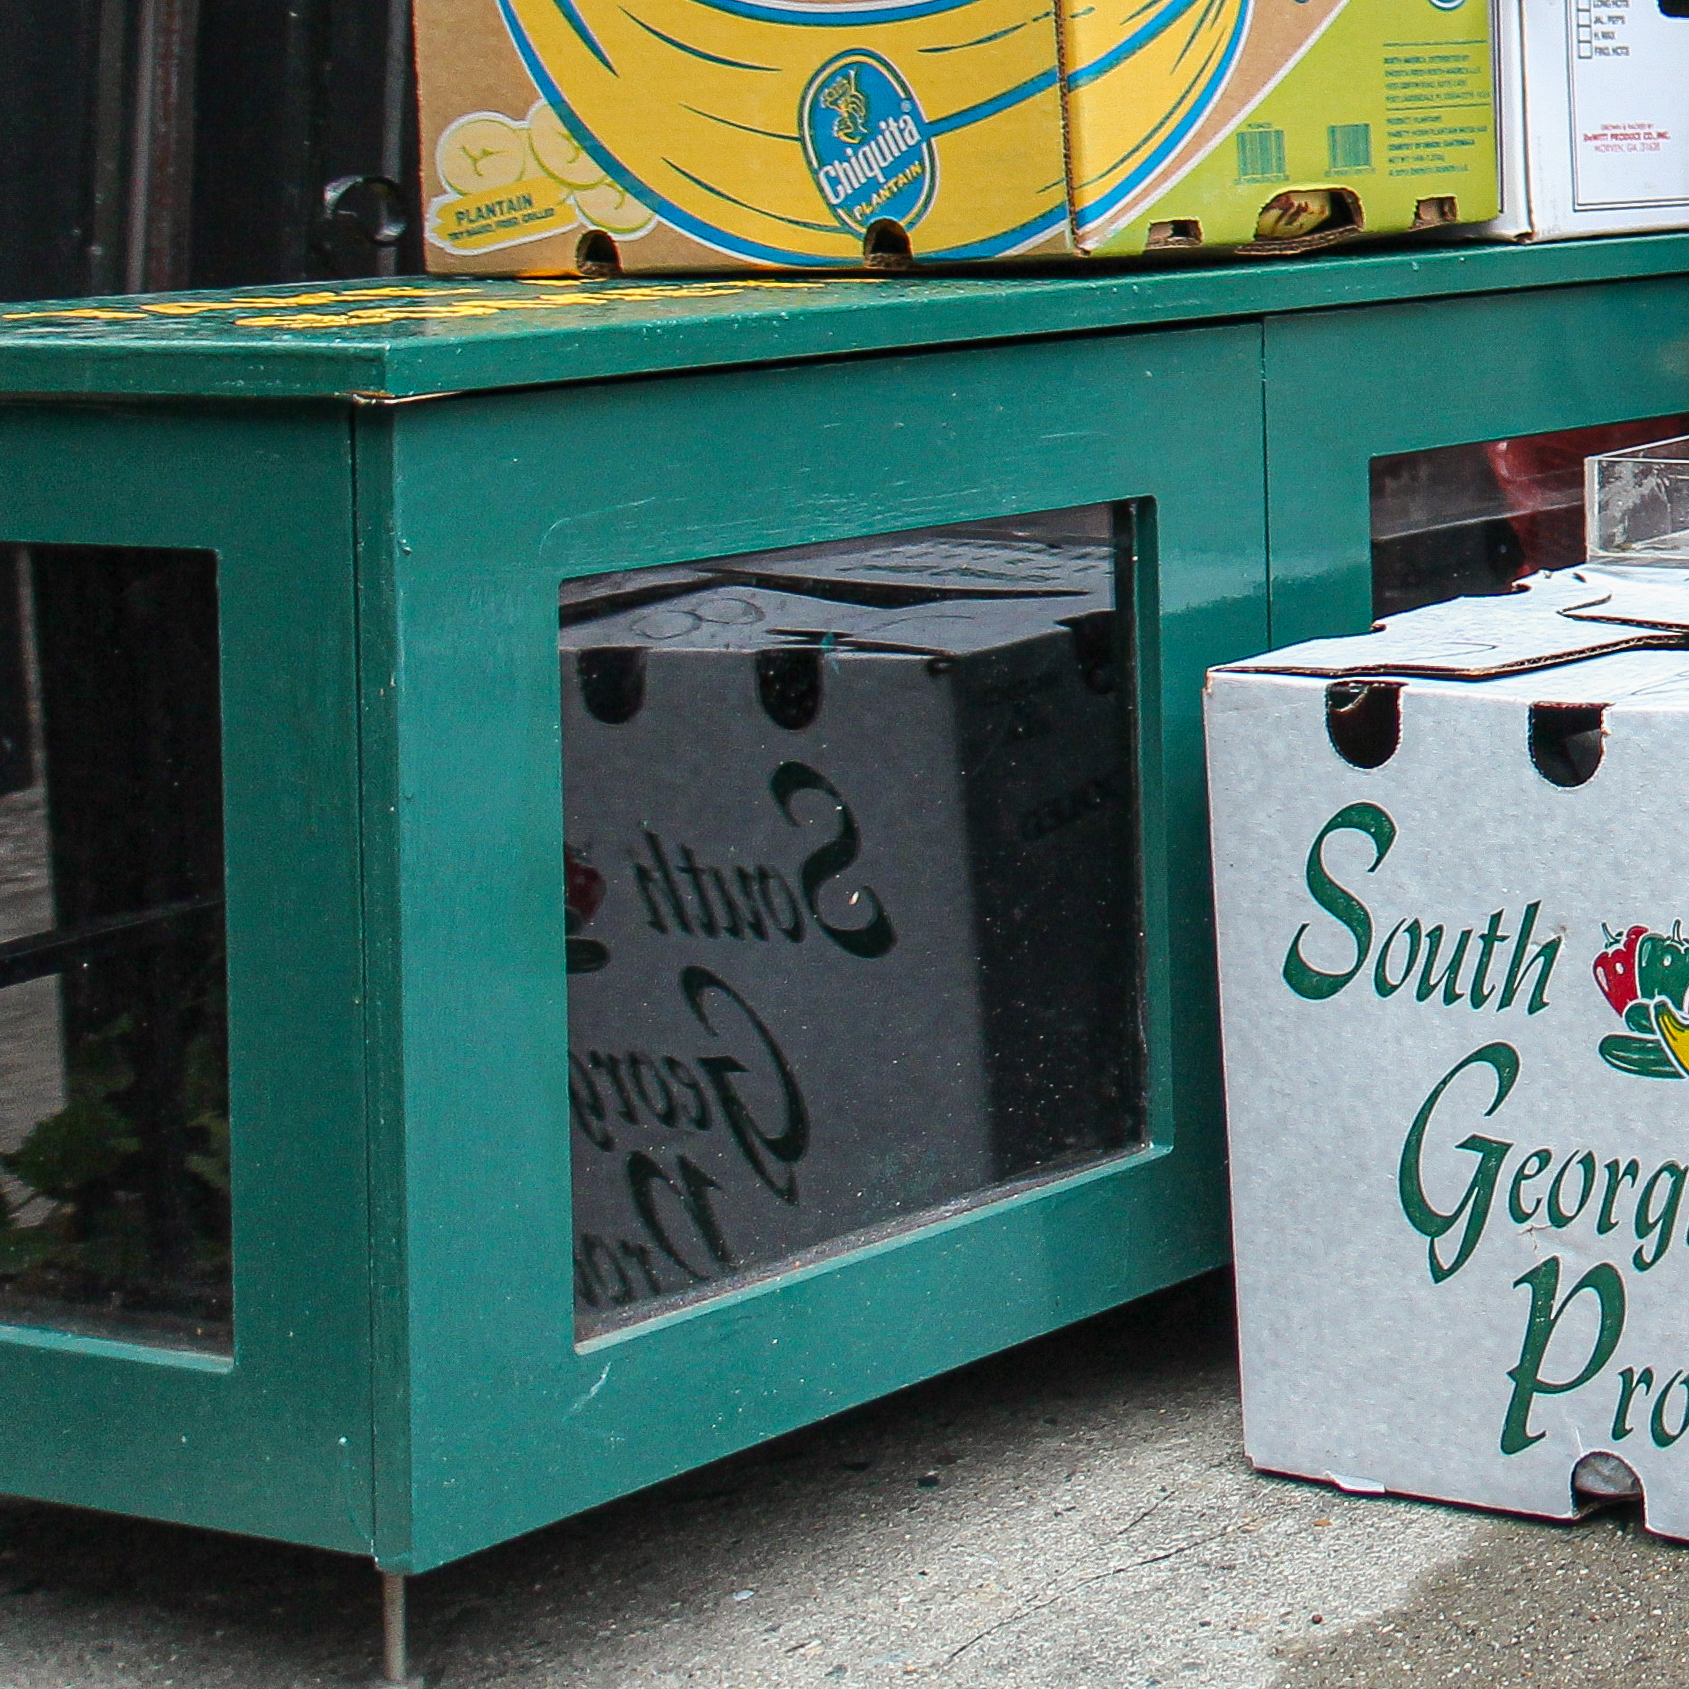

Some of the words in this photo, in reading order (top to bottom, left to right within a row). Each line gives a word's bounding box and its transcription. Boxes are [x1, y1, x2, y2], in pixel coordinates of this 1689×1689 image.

[819, 114, 921, 205] Chiquita
[853, 161, 922, 220] PLANTAIN
[455, 193, 533, 225] PLANTAIN
[1283, 802, 1564, 1018] South
